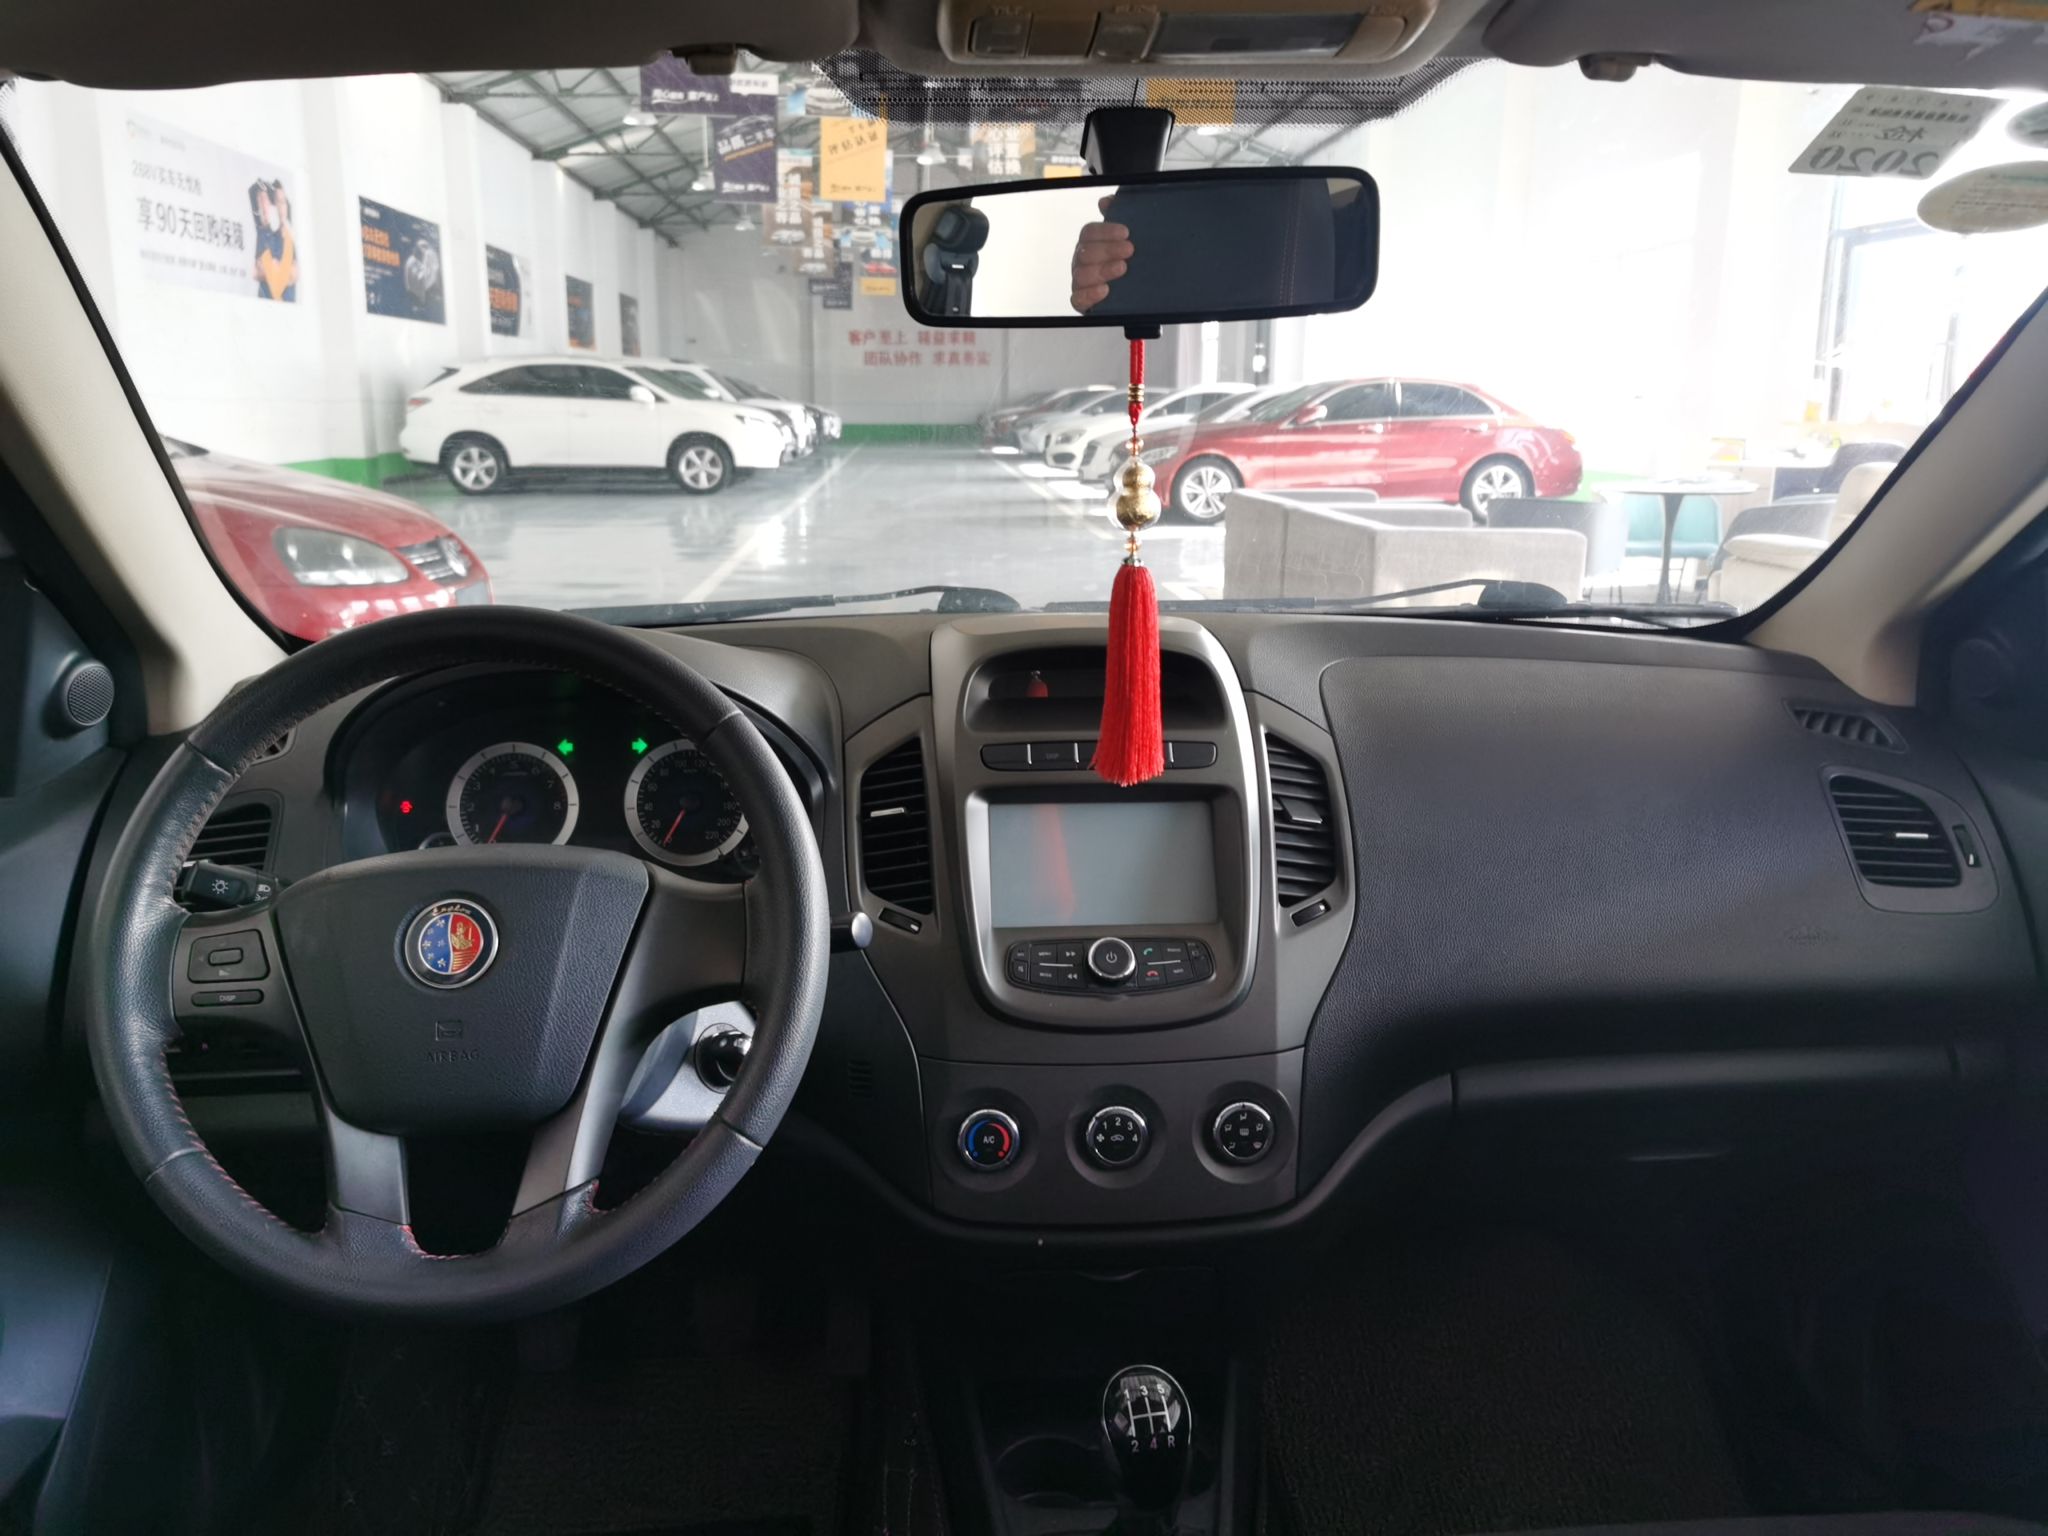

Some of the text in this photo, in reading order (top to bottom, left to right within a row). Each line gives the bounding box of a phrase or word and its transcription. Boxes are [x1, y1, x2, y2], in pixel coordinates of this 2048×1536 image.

[848, 330, 907, 345] 客户至上
[864, 351, 921, 366] 团队协作
[1102, 1120, 1108, 1131] 1
[1115, 1116, 1121, 1127] 2
[1127, 1121, 1134, 1131] 3
[1132, 1133, 1139, 1143] 4
[1123, 1383, 1166, 1399] 1 3 5
[1130, 1434, 1176, 1453] 2 4 R
